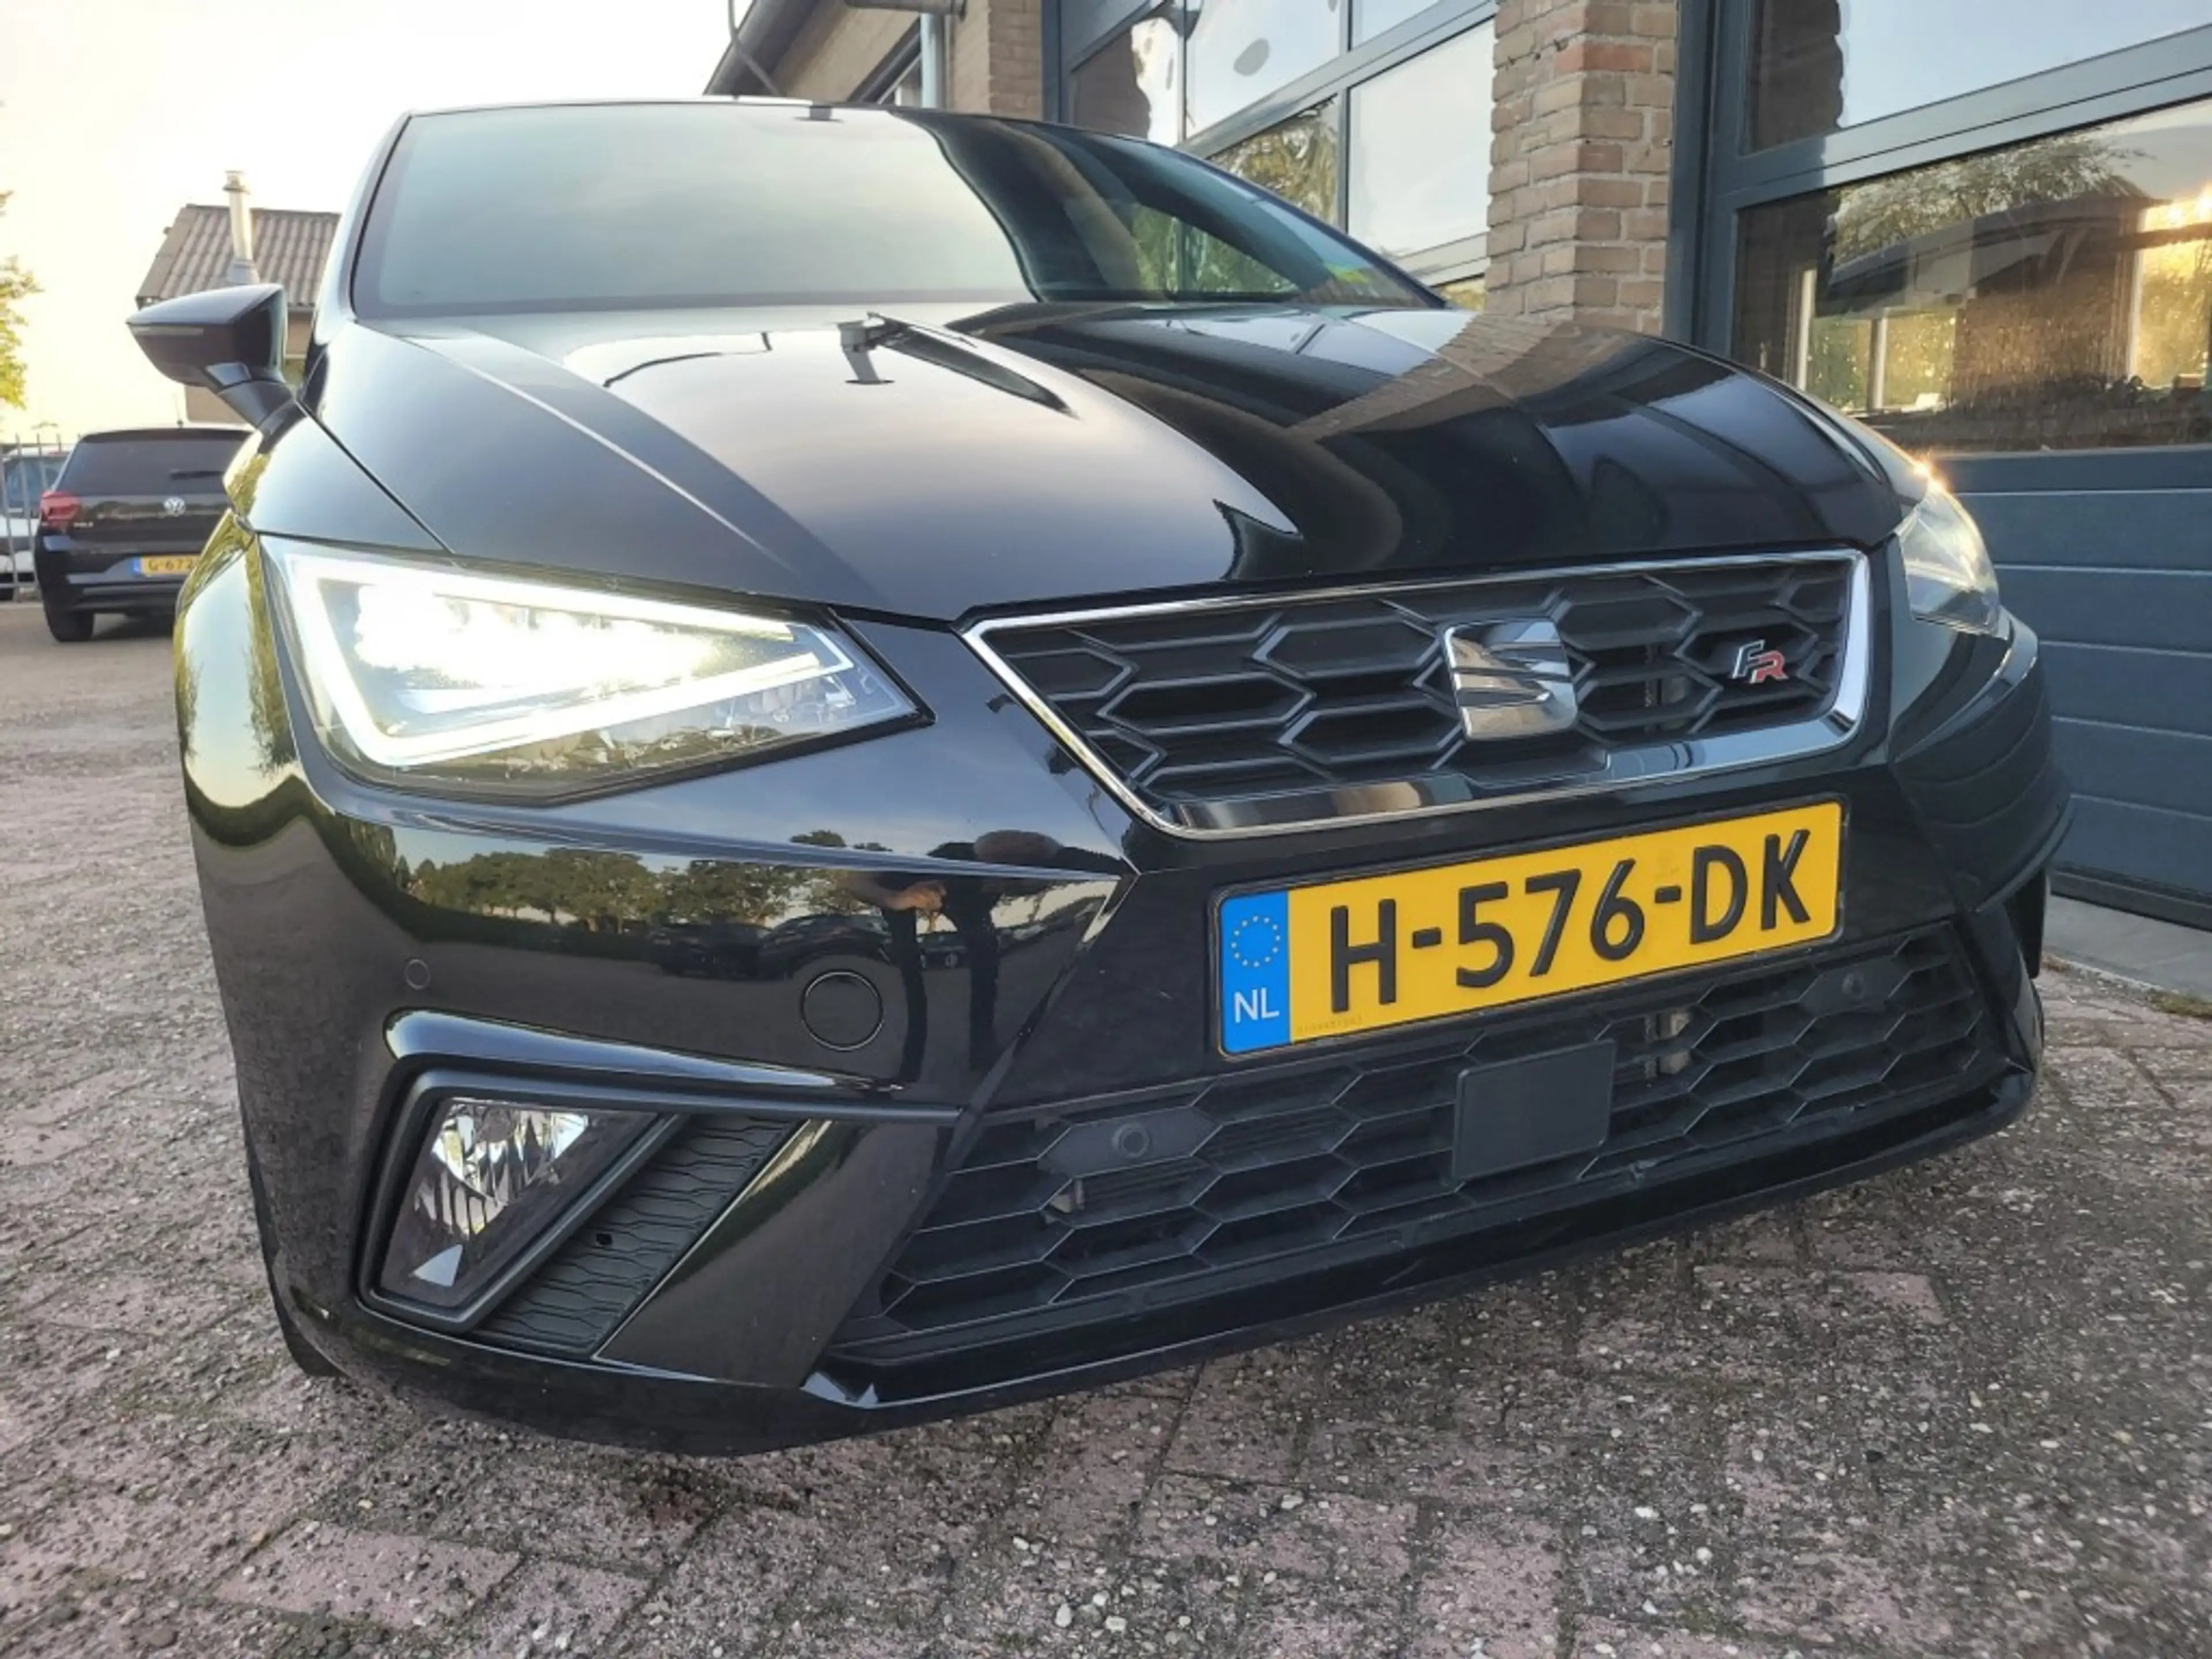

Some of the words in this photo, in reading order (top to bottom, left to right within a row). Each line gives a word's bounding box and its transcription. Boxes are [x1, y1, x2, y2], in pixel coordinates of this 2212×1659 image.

[1732, 639, 1789, 684] FR
[1330, 829, 1811, 1013] H-576-DK
[1234, 987, 1279, 1022] NL
